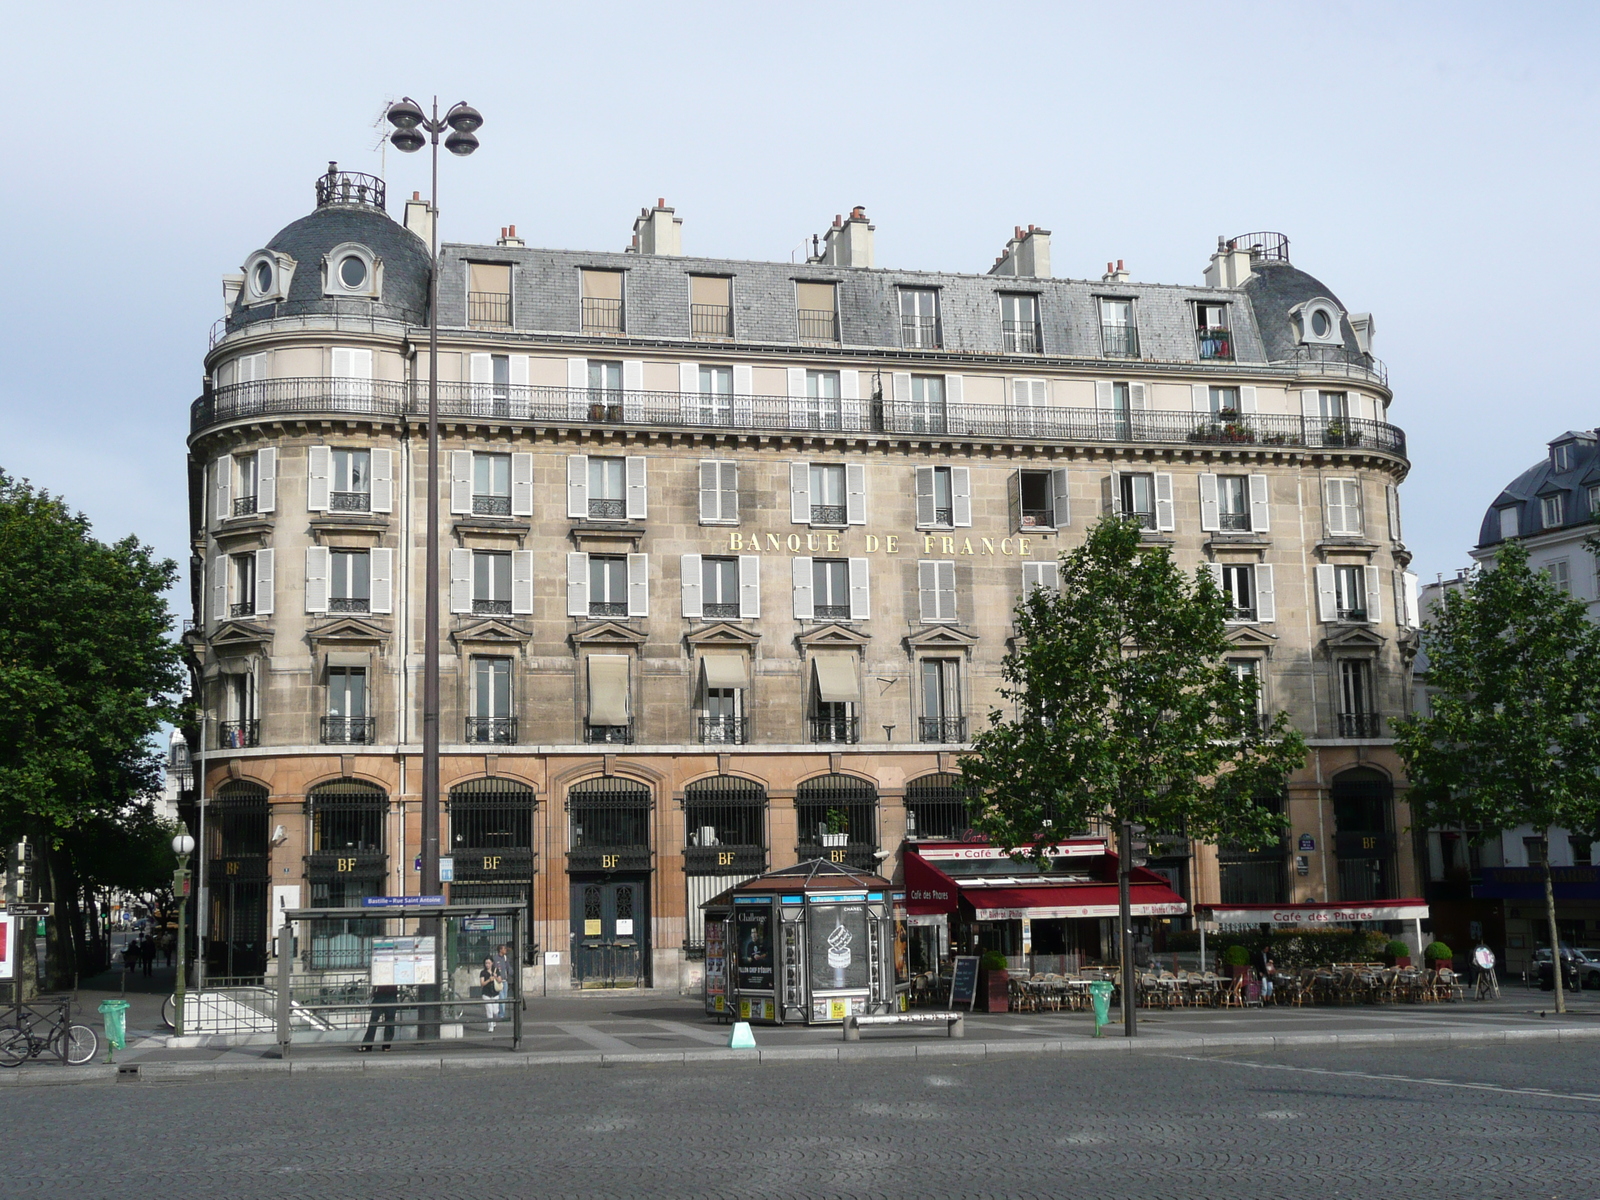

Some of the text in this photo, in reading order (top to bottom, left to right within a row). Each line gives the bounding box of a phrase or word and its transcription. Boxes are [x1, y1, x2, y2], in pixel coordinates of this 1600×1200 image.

[729, 532, 1031, 555] BANQUE DE FRANCE
[1363, 836, 1376, 849] BF
[718, 852, 735, 865] BF
[831, 850, 847, 863] BF
[964, 849, 992, 858] Café
[337, 858, 357, 872] BF
[483, 856, 501, 870] BF
[602, 854, 620, 868] BF
[226, 861, 240, 875] BF
[911, 889, 921, 900] Café
[923, 890, 931, 900] des
[932, 889, 949, 900] Phares
[988, 911, 1006, 919] Bistrot
[1008, 910, 1022, 918] Philo
[1151, 905, 1168, 914] Bistrot
[1170, 905, 1184, 913] Philo
[1273, 911, 1373, 922] Café des Phares
